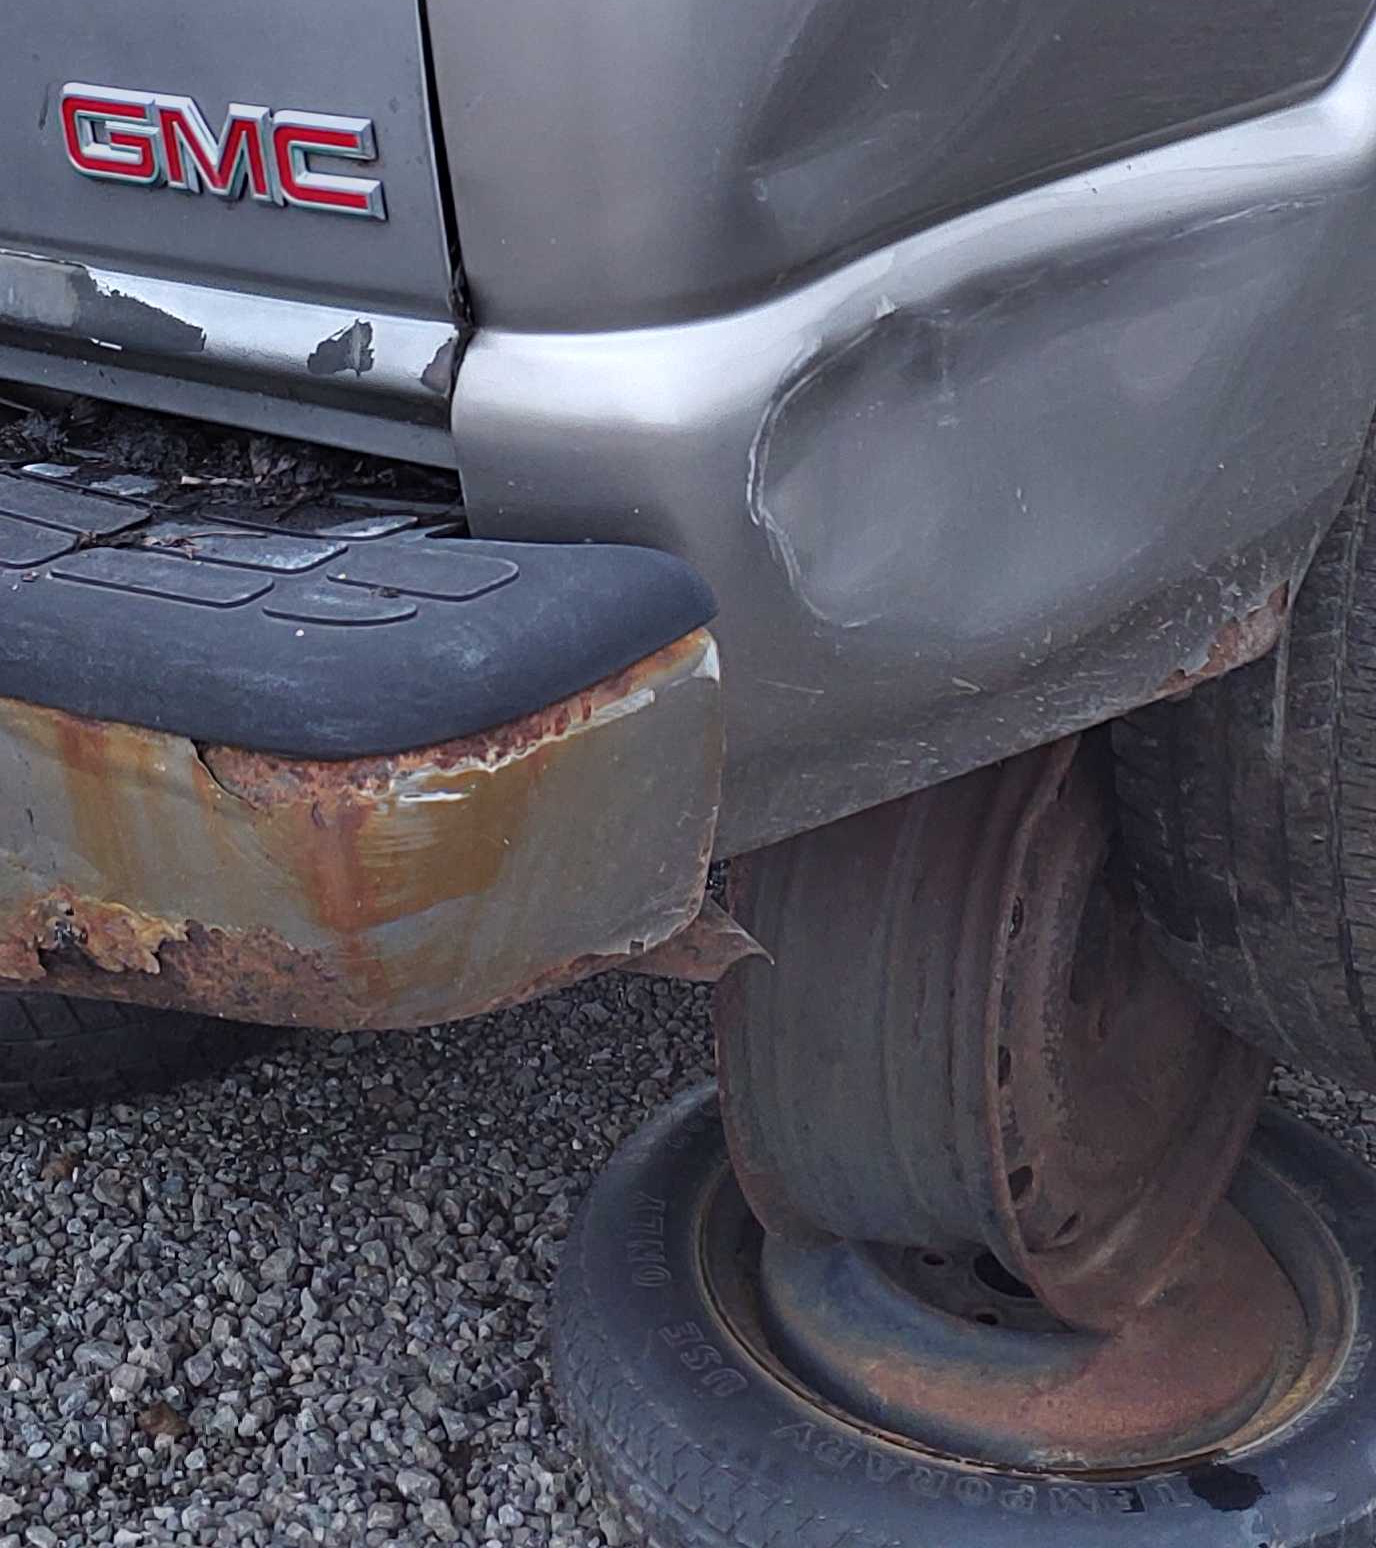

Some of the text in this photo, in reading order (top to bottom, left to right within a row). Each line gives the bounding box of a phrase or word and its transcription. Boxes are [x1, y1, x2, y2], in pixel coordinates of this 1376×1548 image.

[60, 81, 390, 222] GMC
[626, 1189, 674, 1290] ONLY
[657, 1319, 751, 1400] USE
